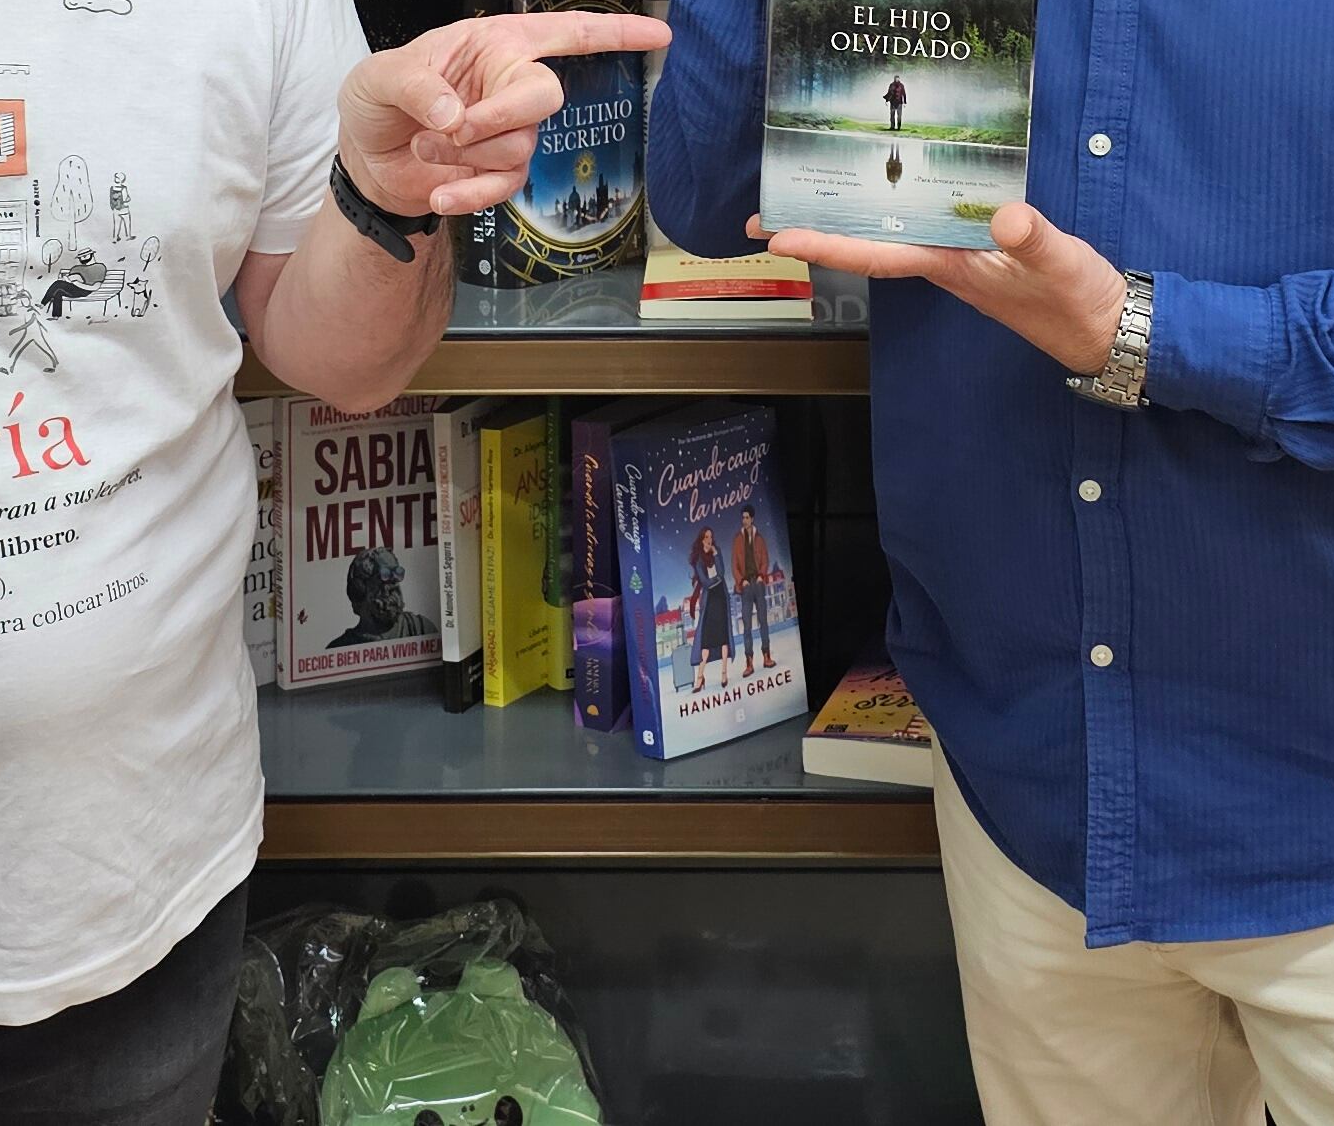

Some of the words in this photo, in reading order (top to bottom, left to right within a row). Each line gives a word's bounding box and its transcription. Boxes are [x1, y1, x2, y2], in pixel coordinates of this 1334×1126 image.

[853, 6, 879, 28] EL
[889, 8, 951, 34] HIJO
[830, 31, 971, 61] OLVIDADO
[563, 99, 632, 129] ÚLTIMO
[541, 122, 626, 155] SECRETO
[44, 496, 57, 511] a
[63, 488, 95, 507] sus
[0, 529, 81, 558] librero.
[32, 591, 105, 630] colocar
[107, 574, 149, 604] libros.
[678, 682, 743, 718] HANNAH
[746, 669, 792, 701] GRACE
